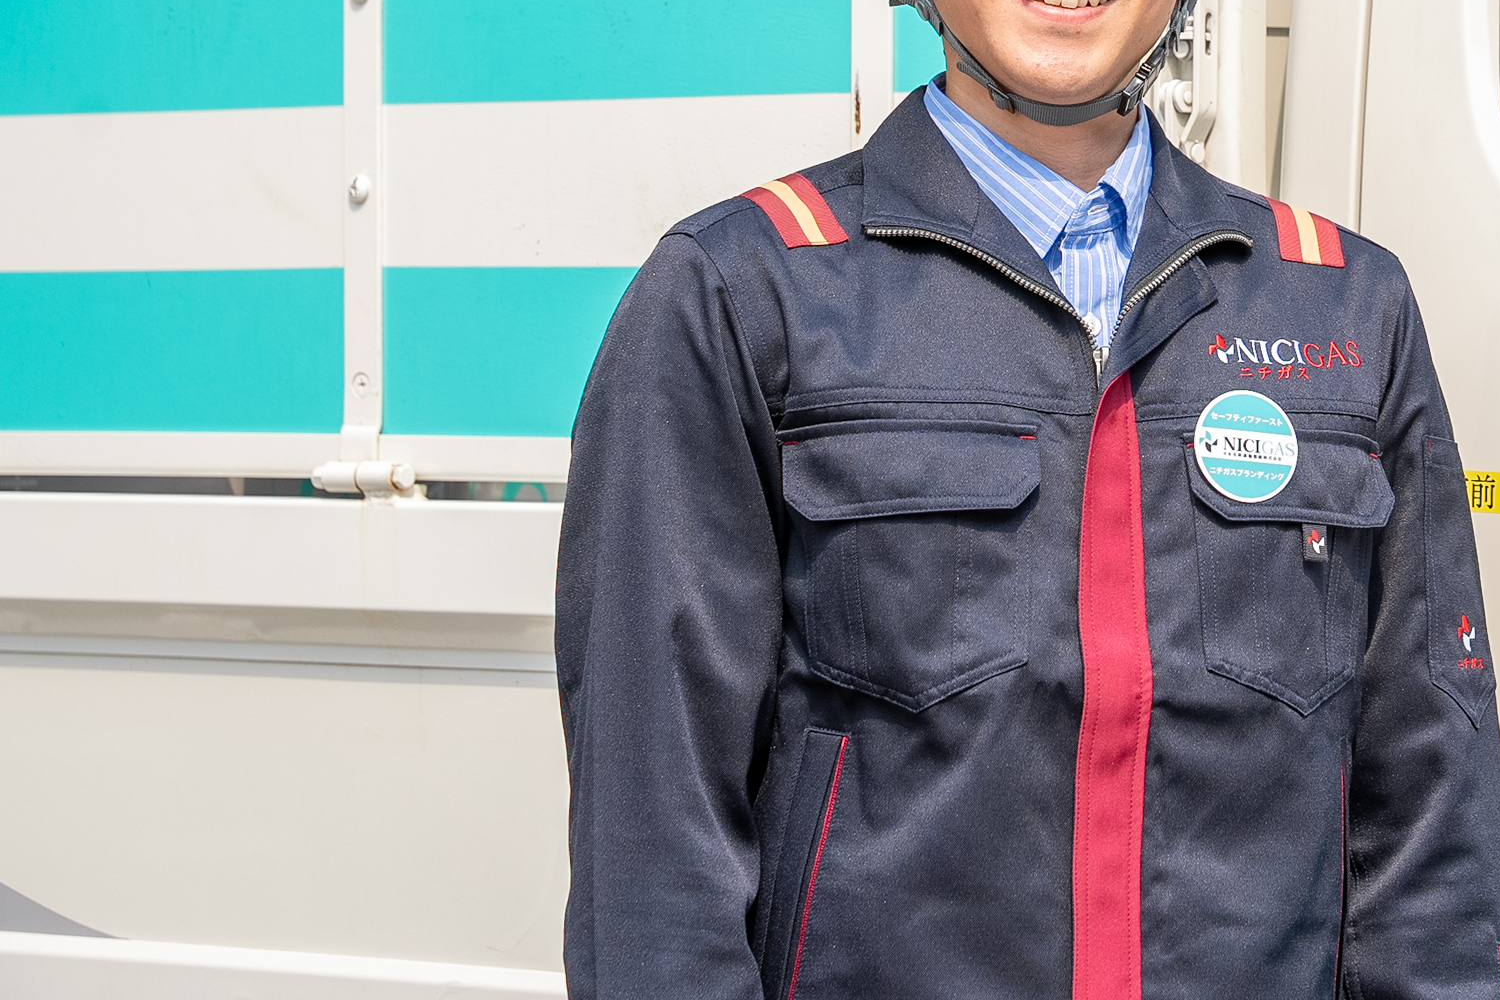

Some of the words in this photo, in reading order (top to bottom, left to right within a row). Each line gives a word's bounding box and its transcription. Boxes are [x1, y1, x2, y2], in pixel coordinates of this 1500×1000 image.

[1234, 337, 1361, 368] NICIGAS
[1239, 365, 1311, 380] ニチガス
[1210, 411, 1284, 427] セーフティファースト
[1223, 436, 1295, 457] NICIGAS
[1209, 466, 1285, 481] ニチガスブランディング
[1464, 474, 1496, 509] 前
